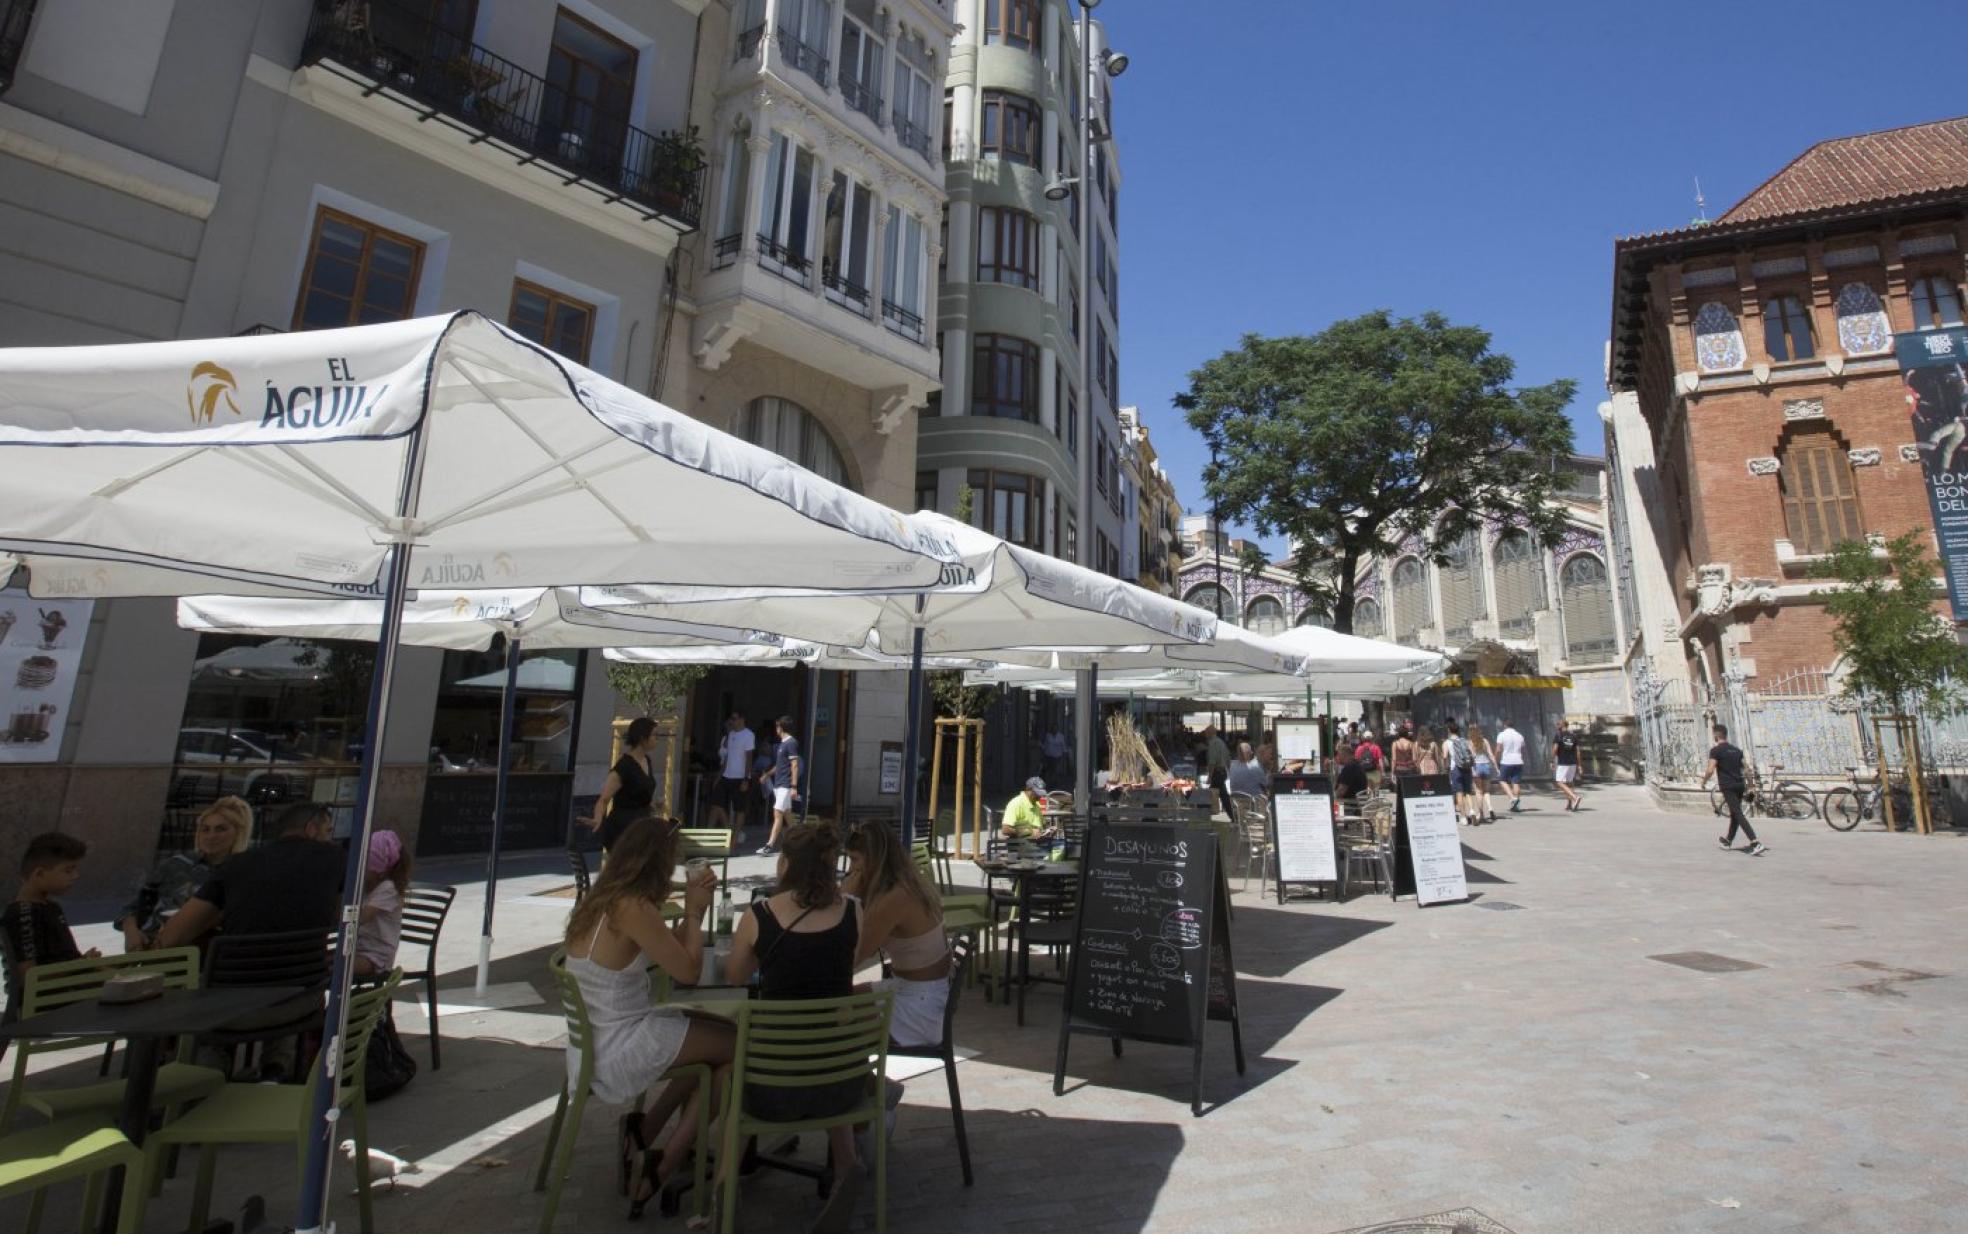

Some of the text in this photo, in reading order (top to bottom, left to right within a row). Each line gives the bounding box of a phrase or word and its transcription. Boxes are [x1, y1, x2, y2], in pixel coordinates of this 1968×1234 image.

[327, 358, 355, 381] EL
[1932, 473, 1954, 485] LO
[1103, 836, 1188, 860] DESAYUNOS
